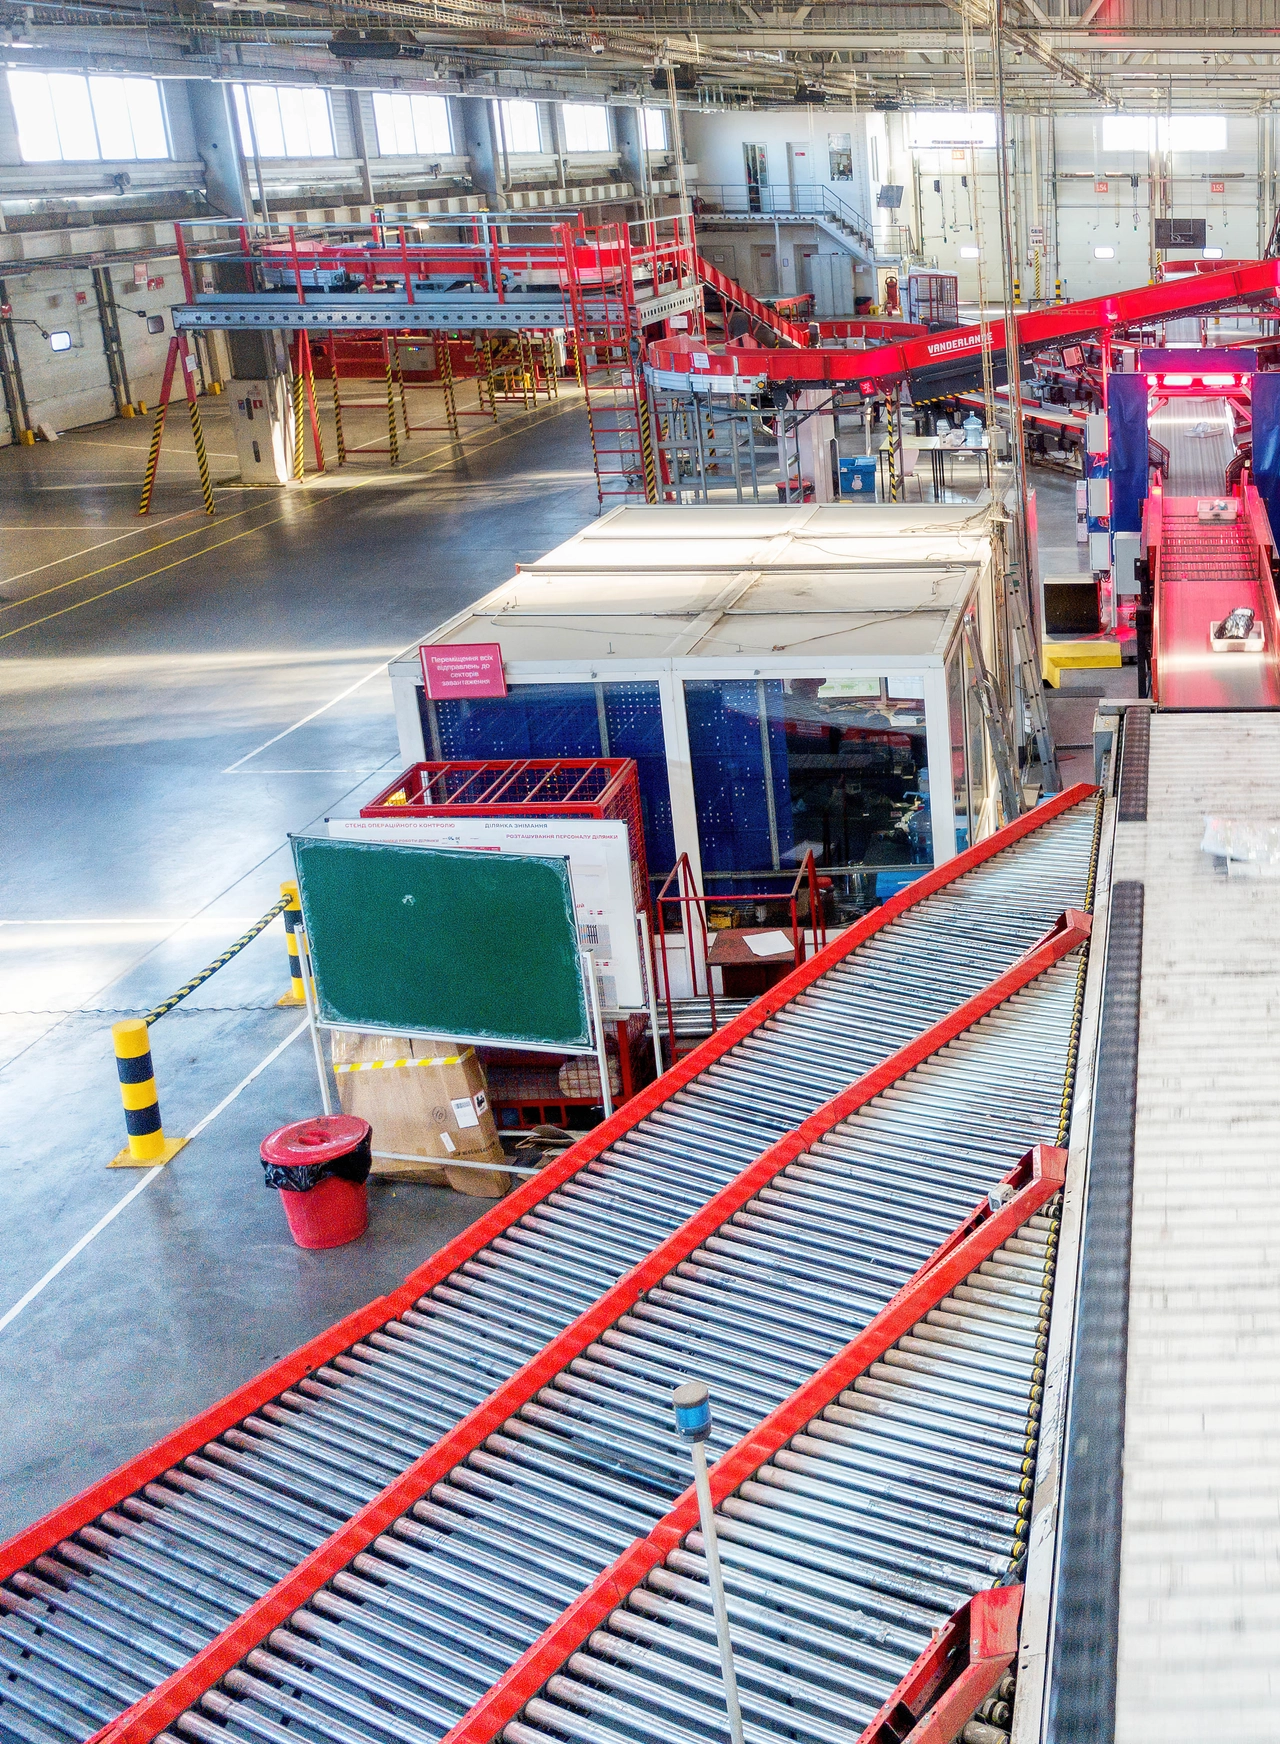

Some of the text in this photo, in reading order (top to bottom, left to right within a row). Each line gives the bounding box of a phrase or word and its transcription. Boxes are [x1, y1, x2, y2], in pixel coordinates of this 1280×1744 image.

[927, 331, 993, 353] VANDERLANE
[431, 656, 478, 664] Переміщення
[437, 664, 480, 672] відправлень
